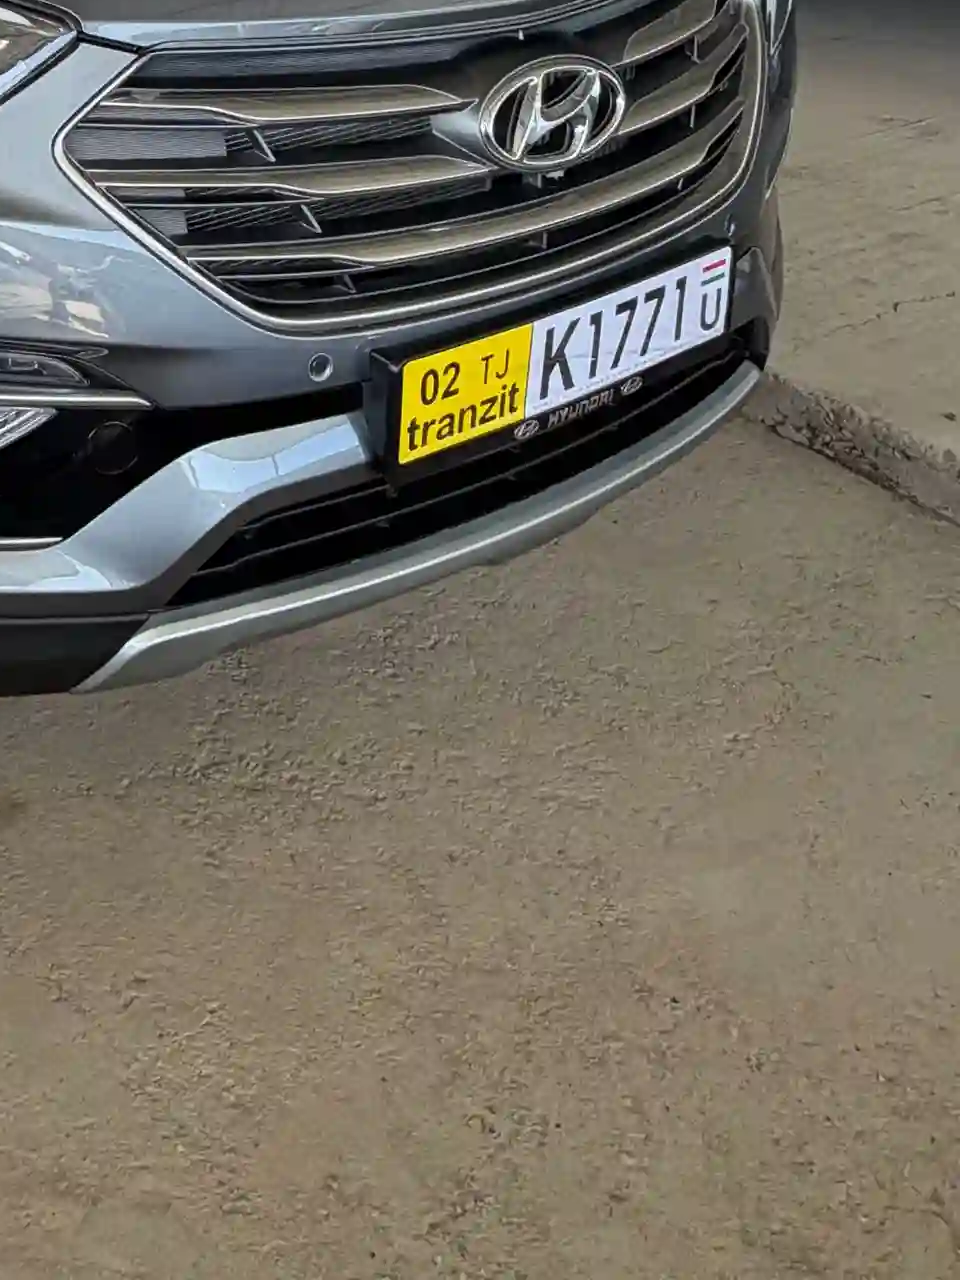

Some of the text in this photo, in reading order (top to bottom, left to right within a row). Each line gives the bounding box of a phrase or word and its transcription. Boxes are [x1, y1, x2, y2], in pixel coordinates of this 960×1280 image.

[420, 361, 461, 406] 02
[481, 348, 510, 385] TJ
[407, 382, 520, 452] tranzit
[547, 388, 618, 429] HYUNDAI
